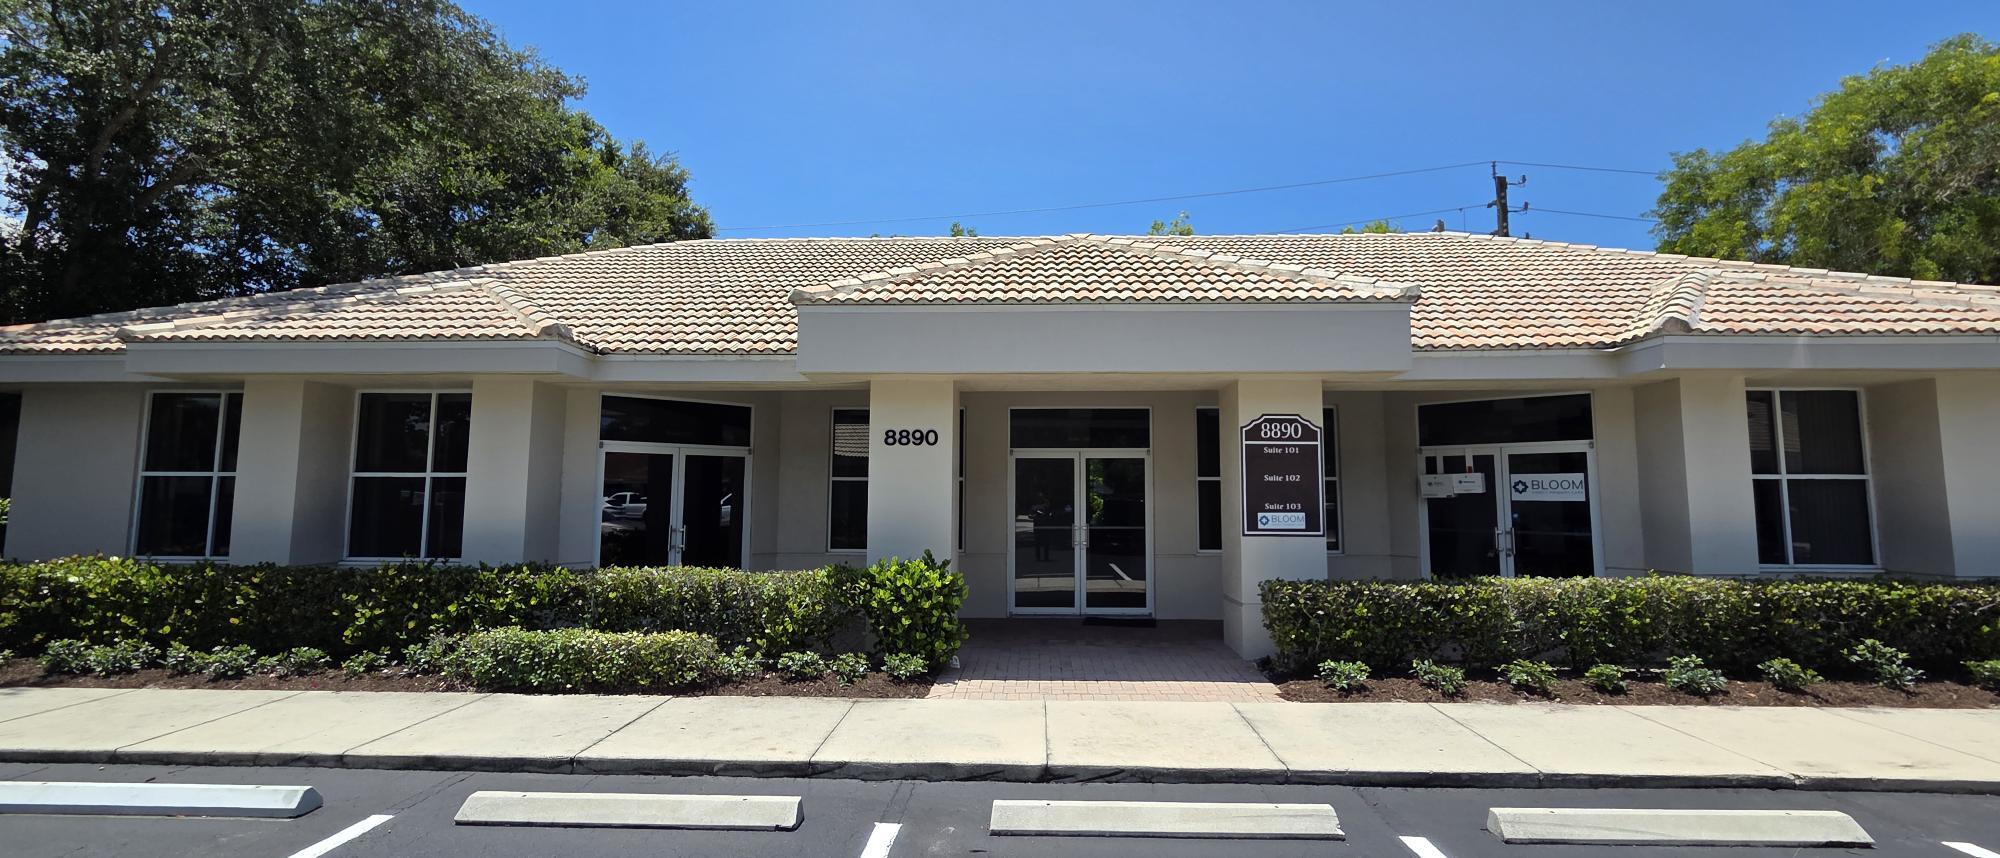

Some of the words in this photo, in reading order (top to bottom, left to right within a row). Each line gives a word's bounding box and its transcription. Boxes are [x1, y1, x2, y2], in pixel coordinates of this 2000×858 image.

[1261, 422, 1302, 439] 8890
[884, 429, 939, 446] 8890
[1263, 446, 1283, 454] Suite
[1285, 446, 1299, 454] 101
[1263, 474, 1283, 482] Suite
[1285, 474, 1301, 482] 102
[1531, 479, 1584, 490] BLOOM
[1264, 502, 1284, 510] Suite
[1271, 514, 1305, 523] BLOOM
